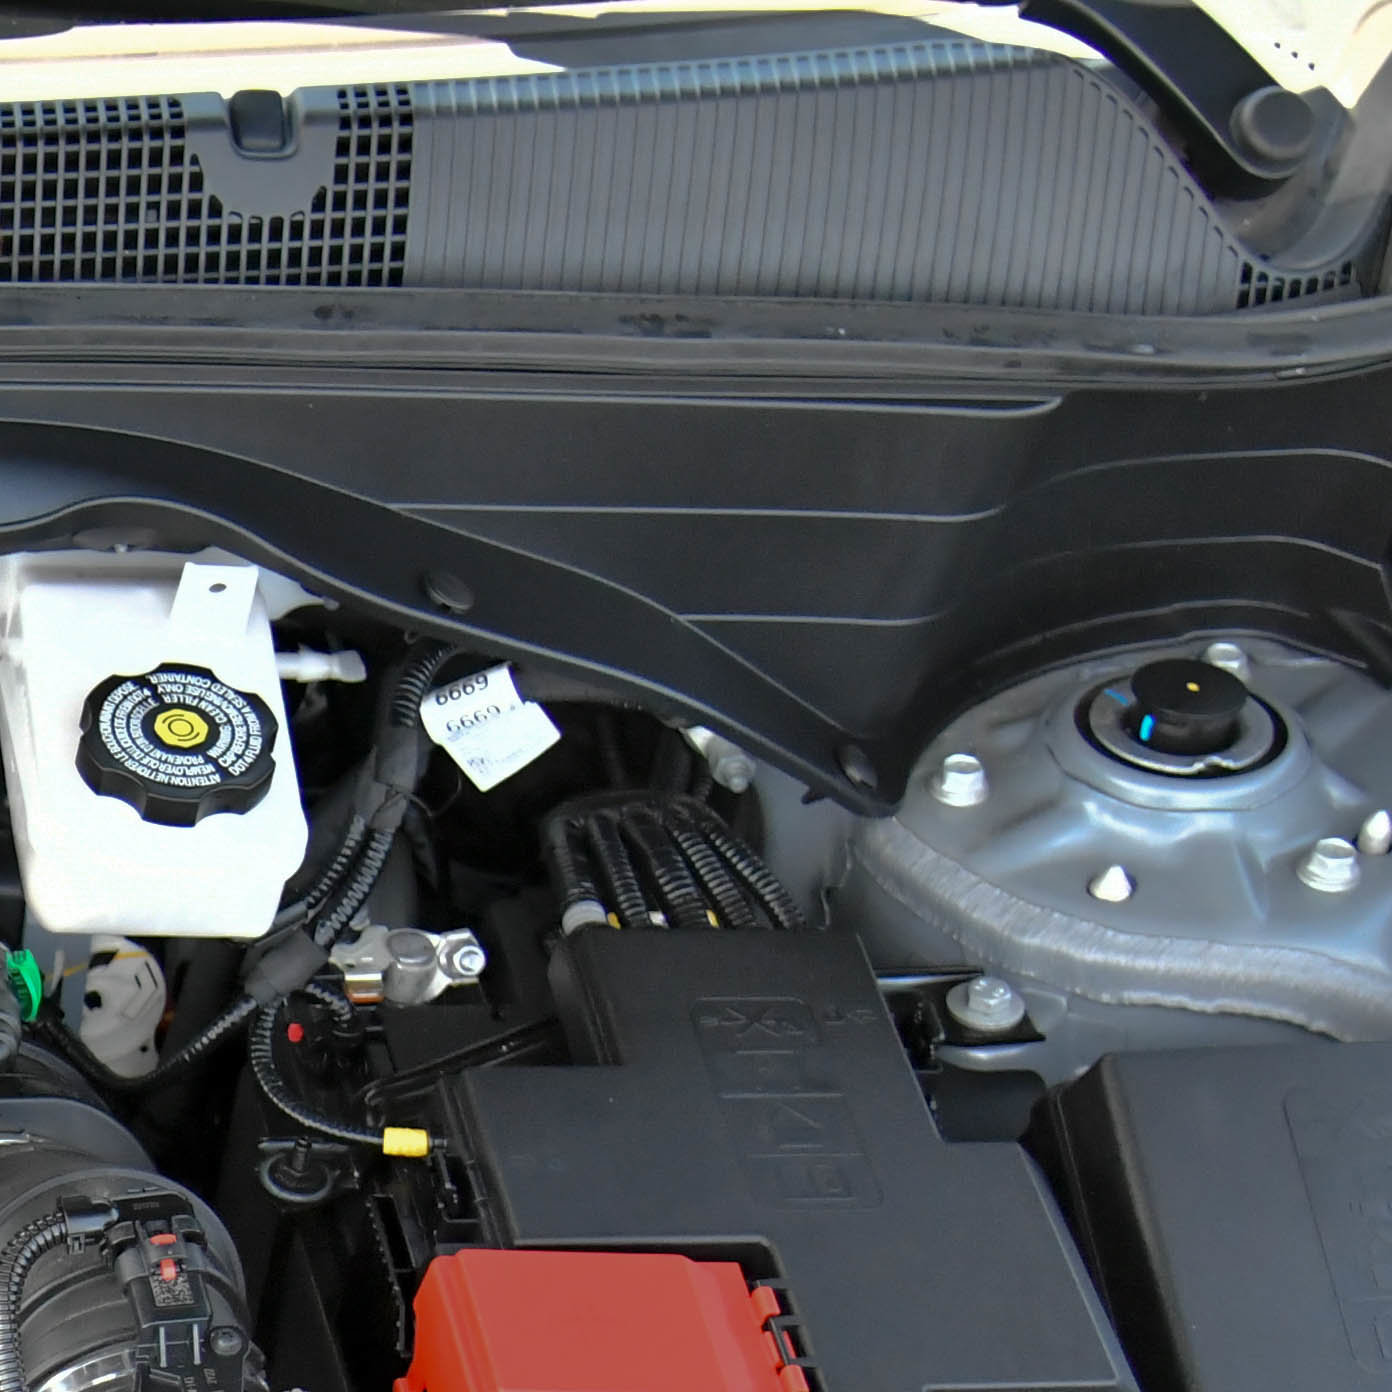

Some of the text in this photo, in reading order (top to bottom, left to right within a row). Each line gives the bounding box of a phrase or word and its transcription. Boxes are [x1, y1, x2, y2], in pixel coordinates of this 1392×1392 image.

[154, 683, 183, 693] ONLY
[185, 684, 206, 697] USE
[211, 684, 246, 708] SEALED
[435, 673, 489, 706] 6669
[162, 694, 198, 706] FILLER
[198, 700, 227, 723] CLEAN
[240, 711, 261, 734] FROM
[230, 723, 246, 754] BEFORE
[245, 736, 262, 758] FLUID
[114, 752, 128, 761] LE
[139, 756, 160, 768] QUE
[218, 750, 240, 767] CAP
[228, 759, 249, 775] DOT
